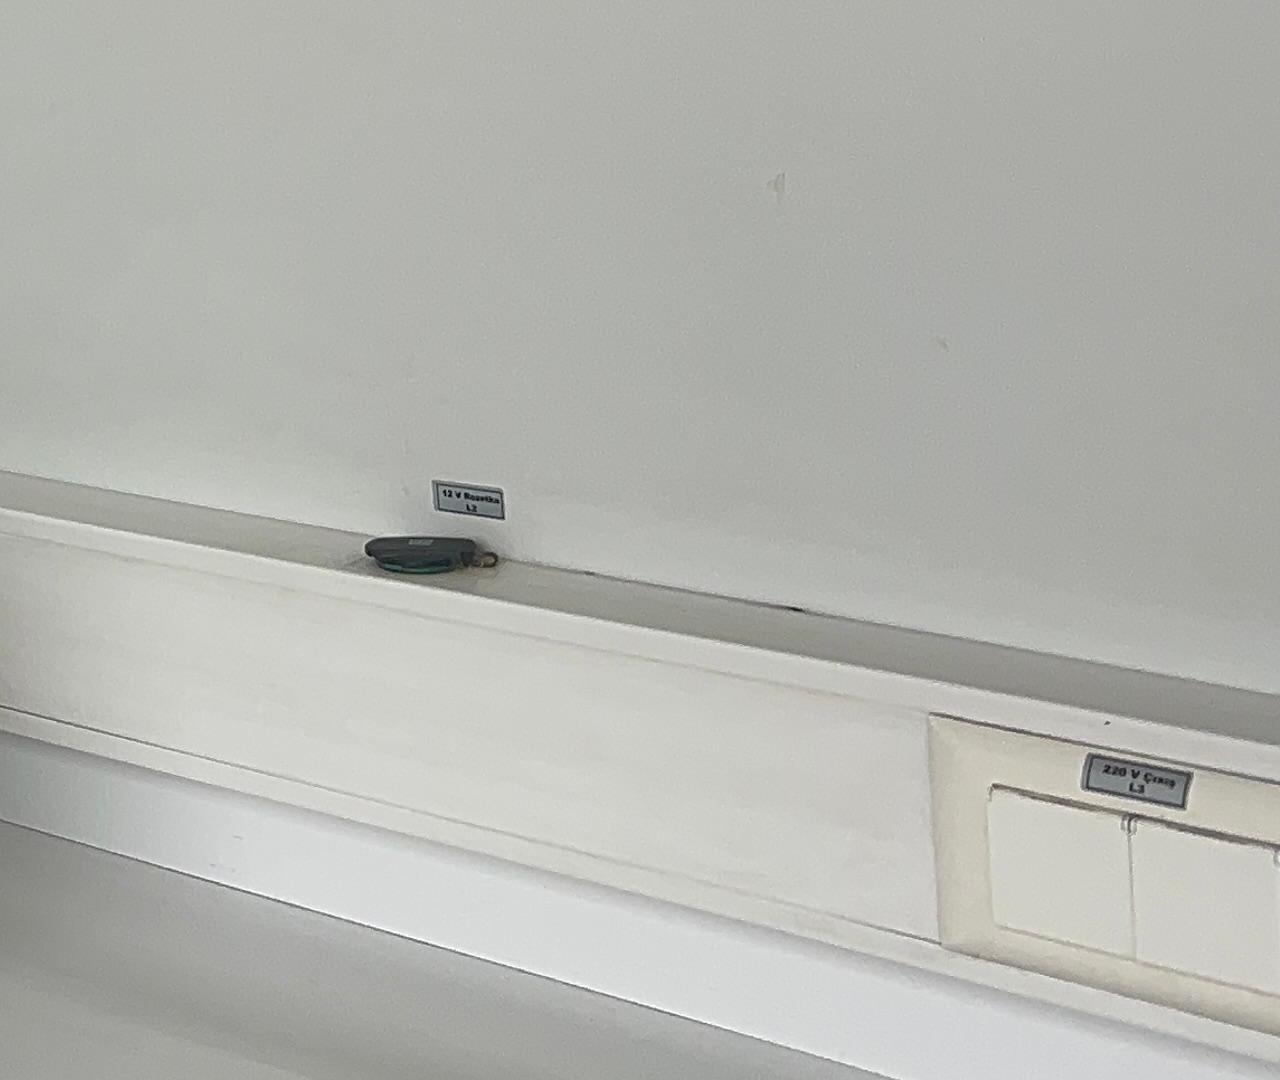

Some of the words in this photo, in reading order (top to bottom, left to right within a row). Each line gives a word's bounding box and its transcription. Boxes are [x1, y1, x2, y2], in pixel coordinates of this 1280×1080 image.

[442, 489, 452, 498] 12
[1103, 764, 1127, 777] 220
[1131, 769, 1140, 779] V
